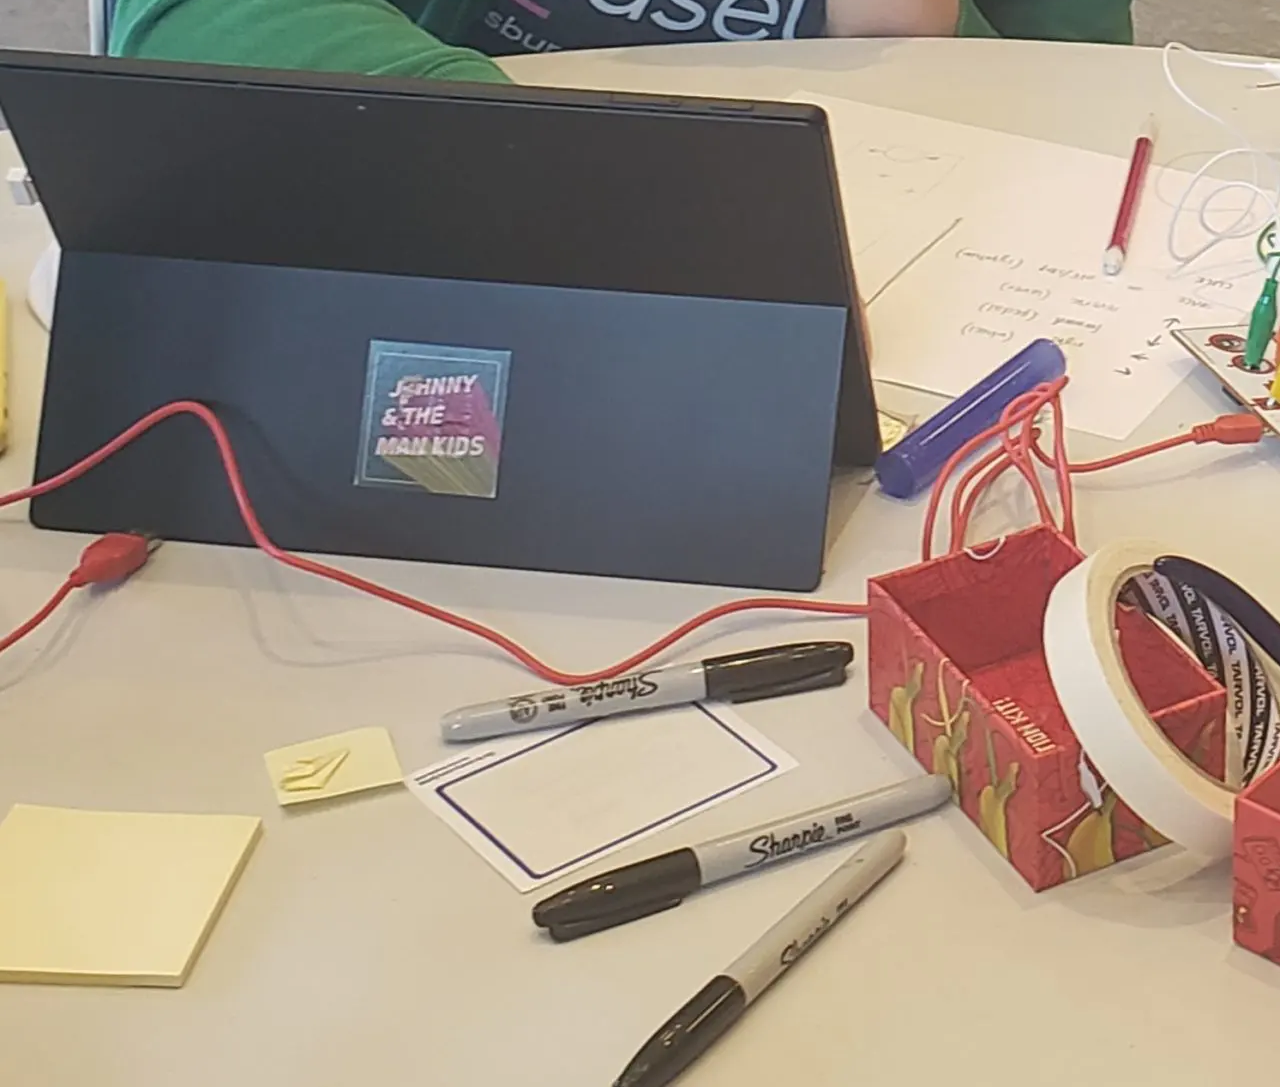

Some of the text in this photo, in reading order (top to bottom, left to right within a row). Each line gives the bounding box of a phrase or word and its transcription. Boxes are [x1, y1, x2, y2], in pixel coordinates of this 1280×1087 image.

[381, 404, 447, 427] & THE
[374, 435, 486, 457] MAN KIDS
[1190, 606, 1212, 658] TARVOL
[575, 669, 664, 708] Sharpie
[1231, 659, 1245, 720] TARVOL
[744, 821, 827, 869] Sharpie
